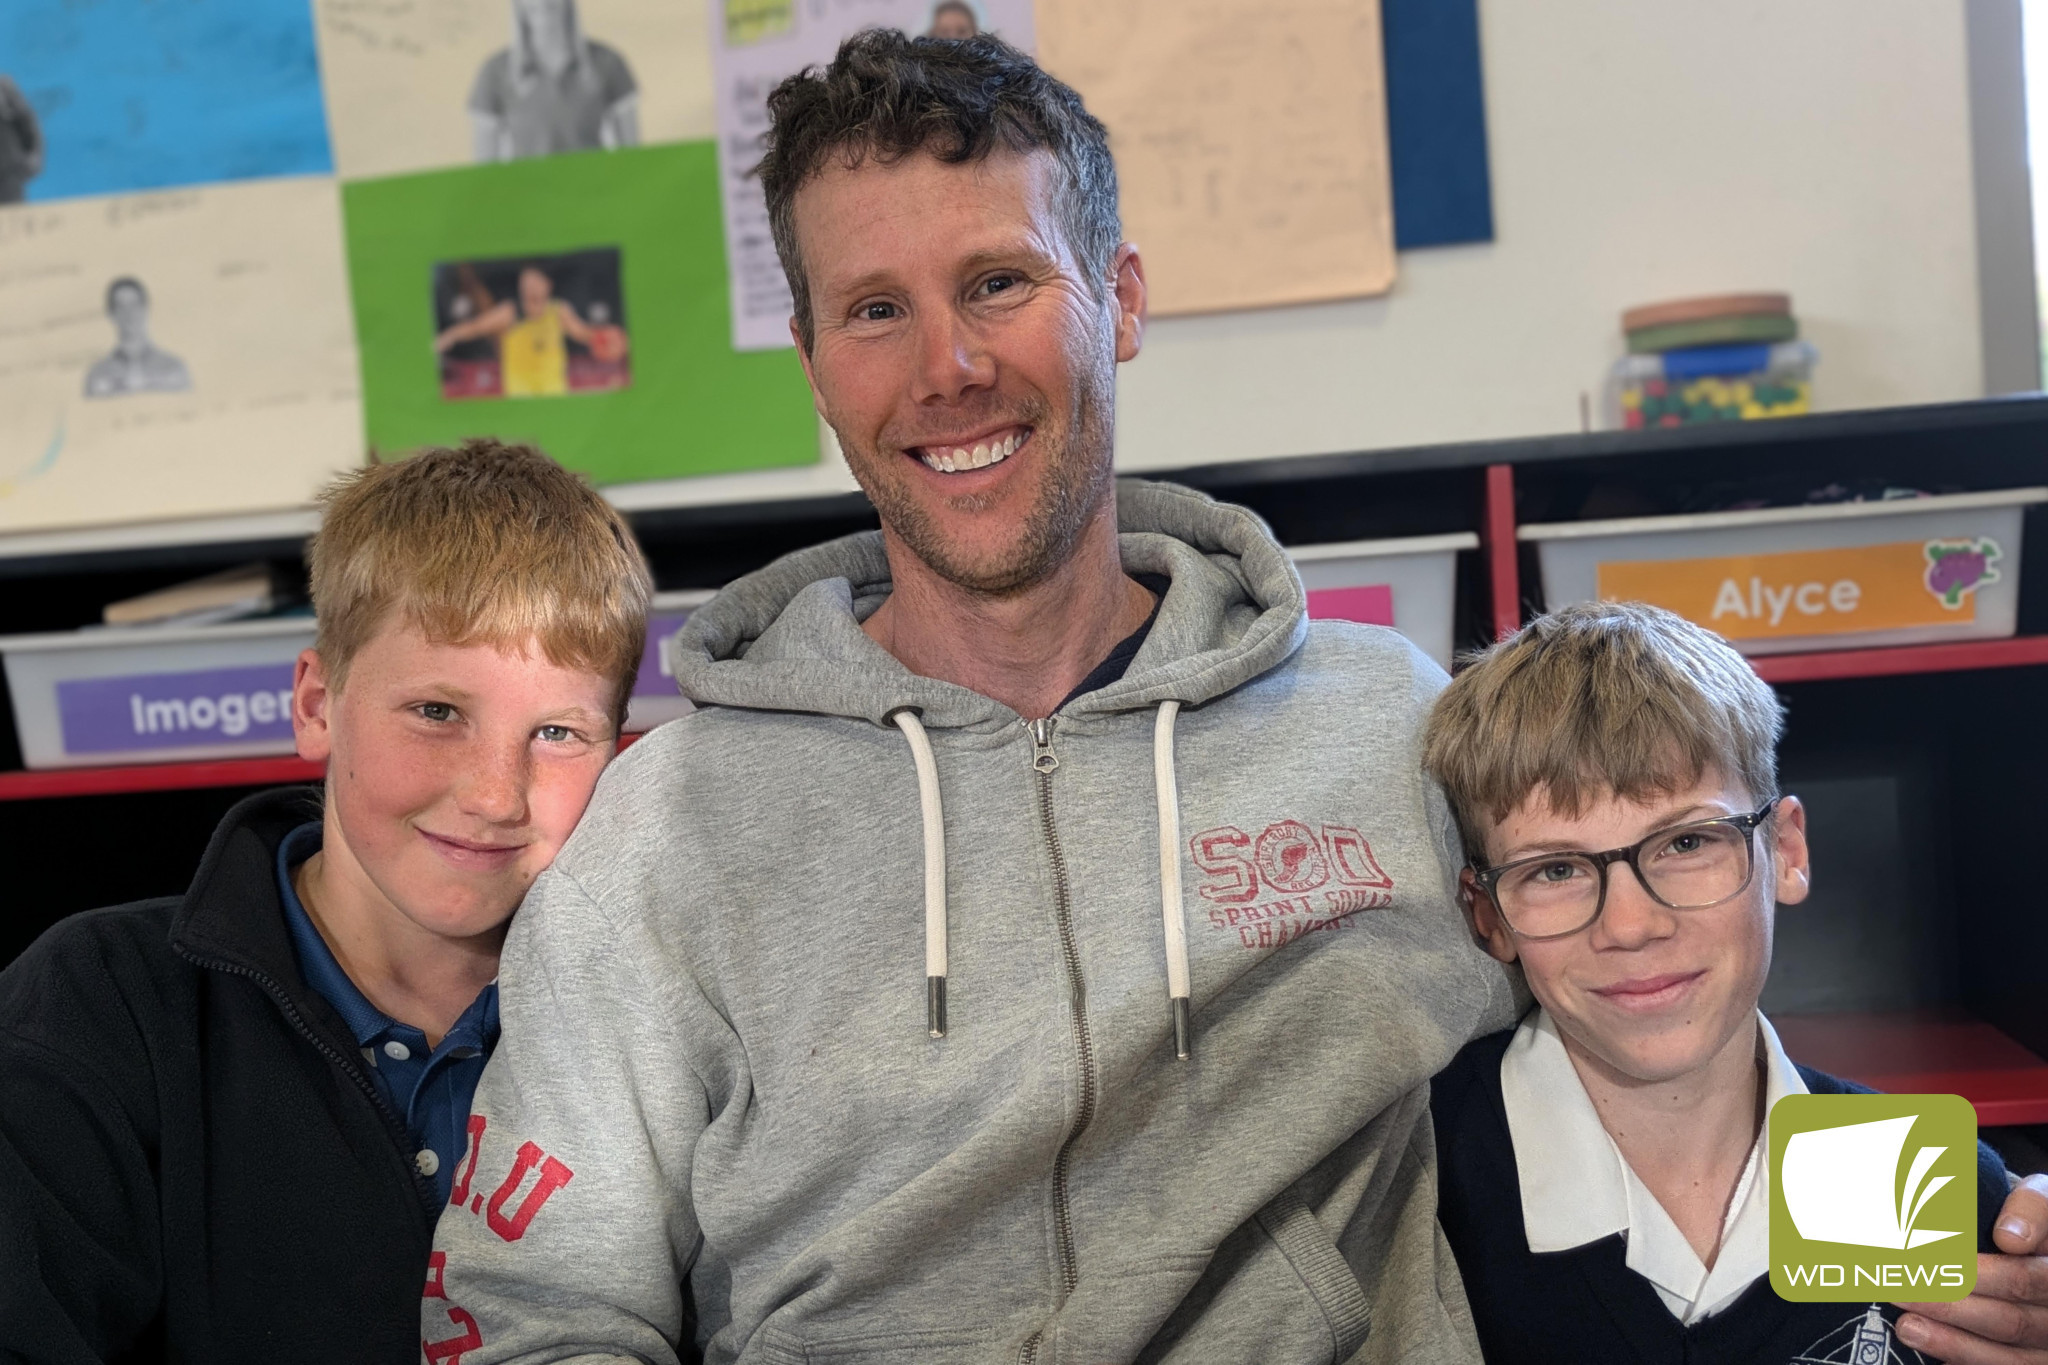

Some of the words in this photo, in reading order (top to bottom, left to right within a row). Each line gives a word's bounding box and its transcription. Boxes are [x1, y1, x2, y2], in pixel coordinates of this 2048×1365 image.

[1711, 576, 1861, 627] Alyce
[1036, 748, 1052, 756] DRY
[1209, 895, 1313, 929] SPRINT
